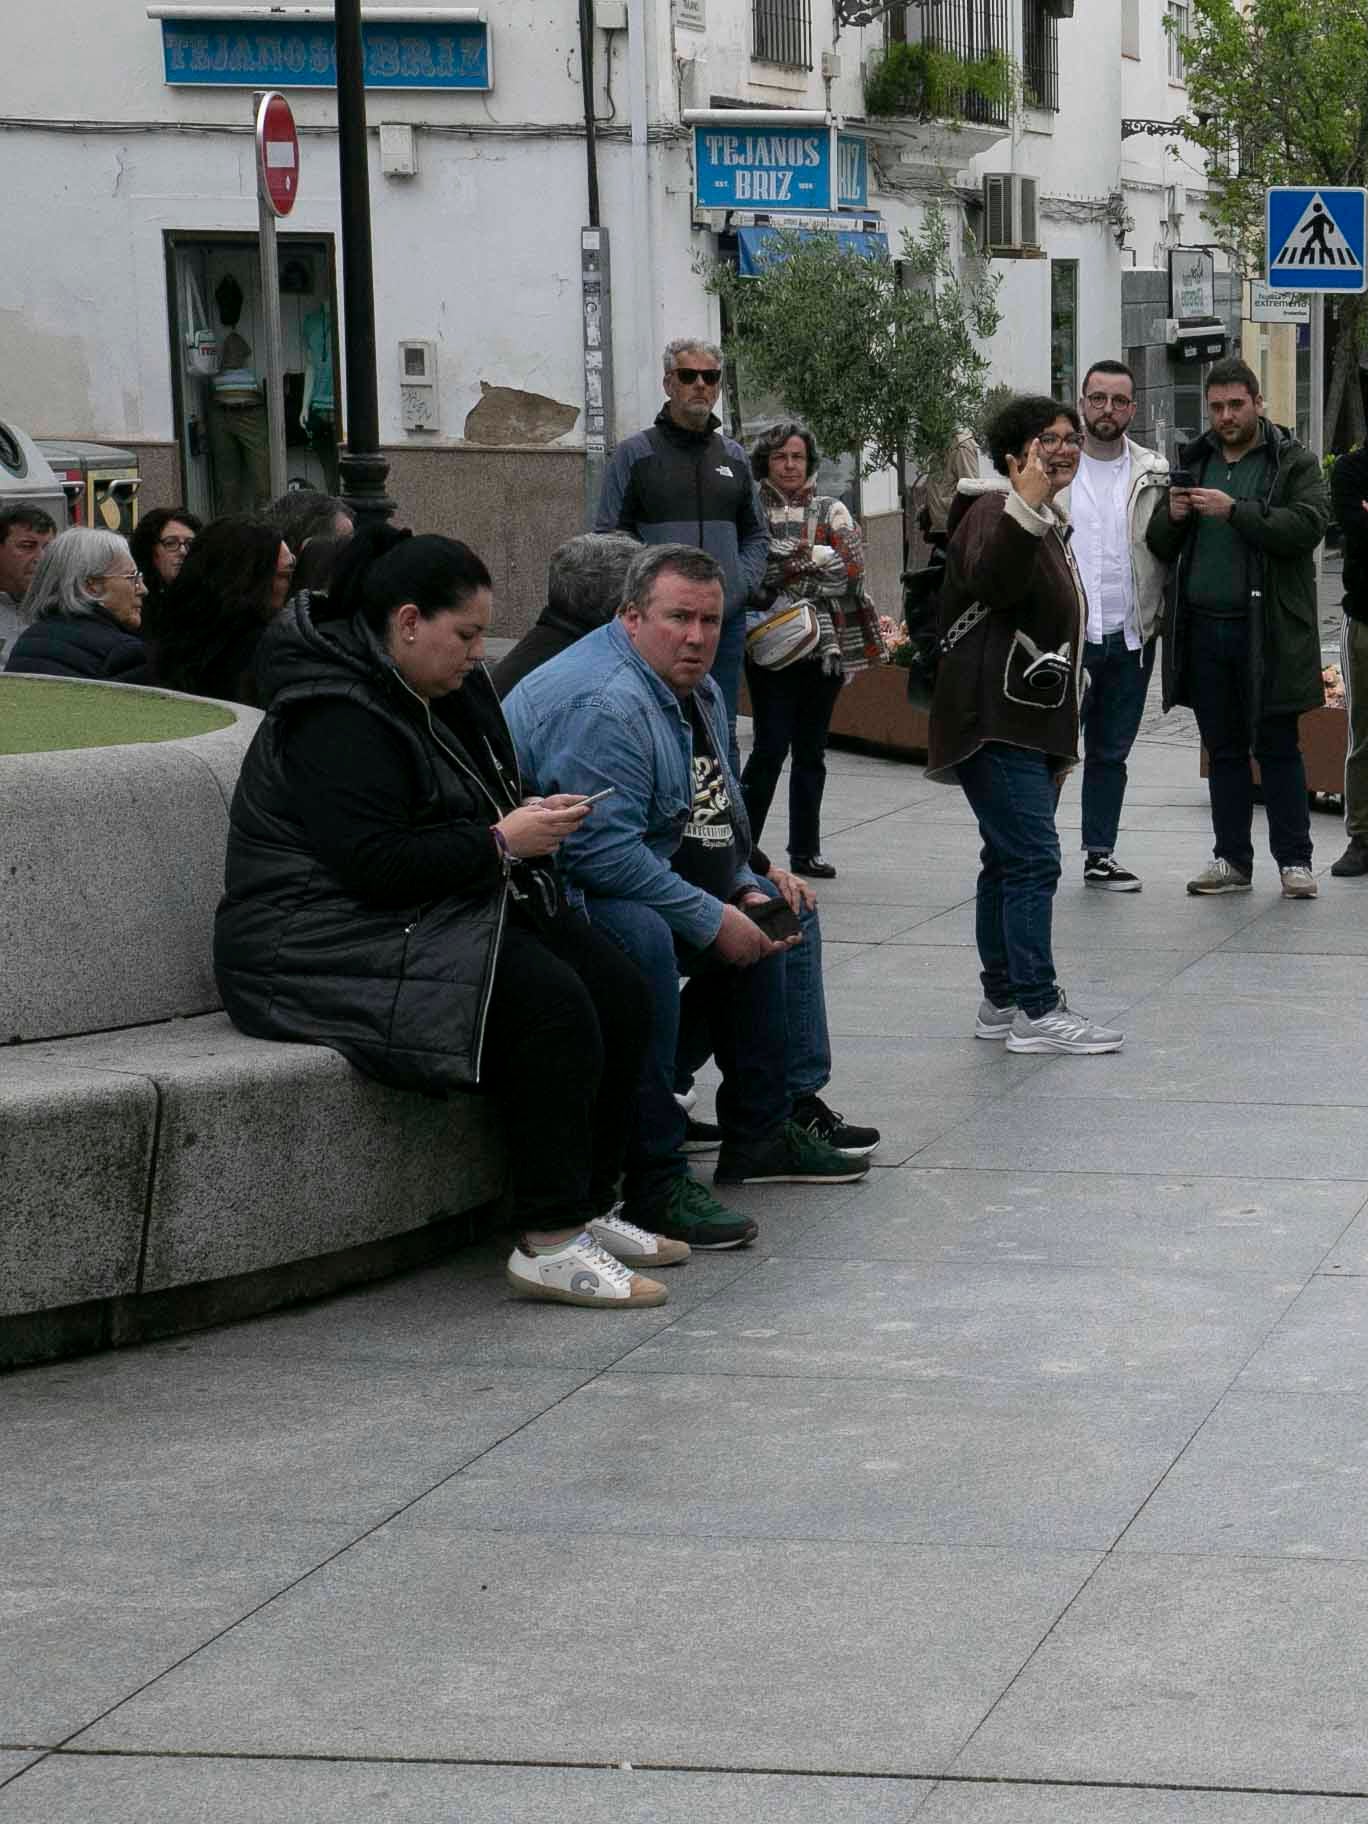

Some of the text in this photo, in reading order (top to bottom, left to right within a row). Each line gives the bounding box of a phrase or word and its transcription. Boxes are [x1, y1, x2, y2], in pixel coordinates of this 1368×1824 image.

[167, 34, 486, 78] TEJANOS BRIZ
[706, 135, 820, 167] TEJANOS
[735, 169, 794, 201] BRIZ
[839, 142, 861, 201] RIZ
